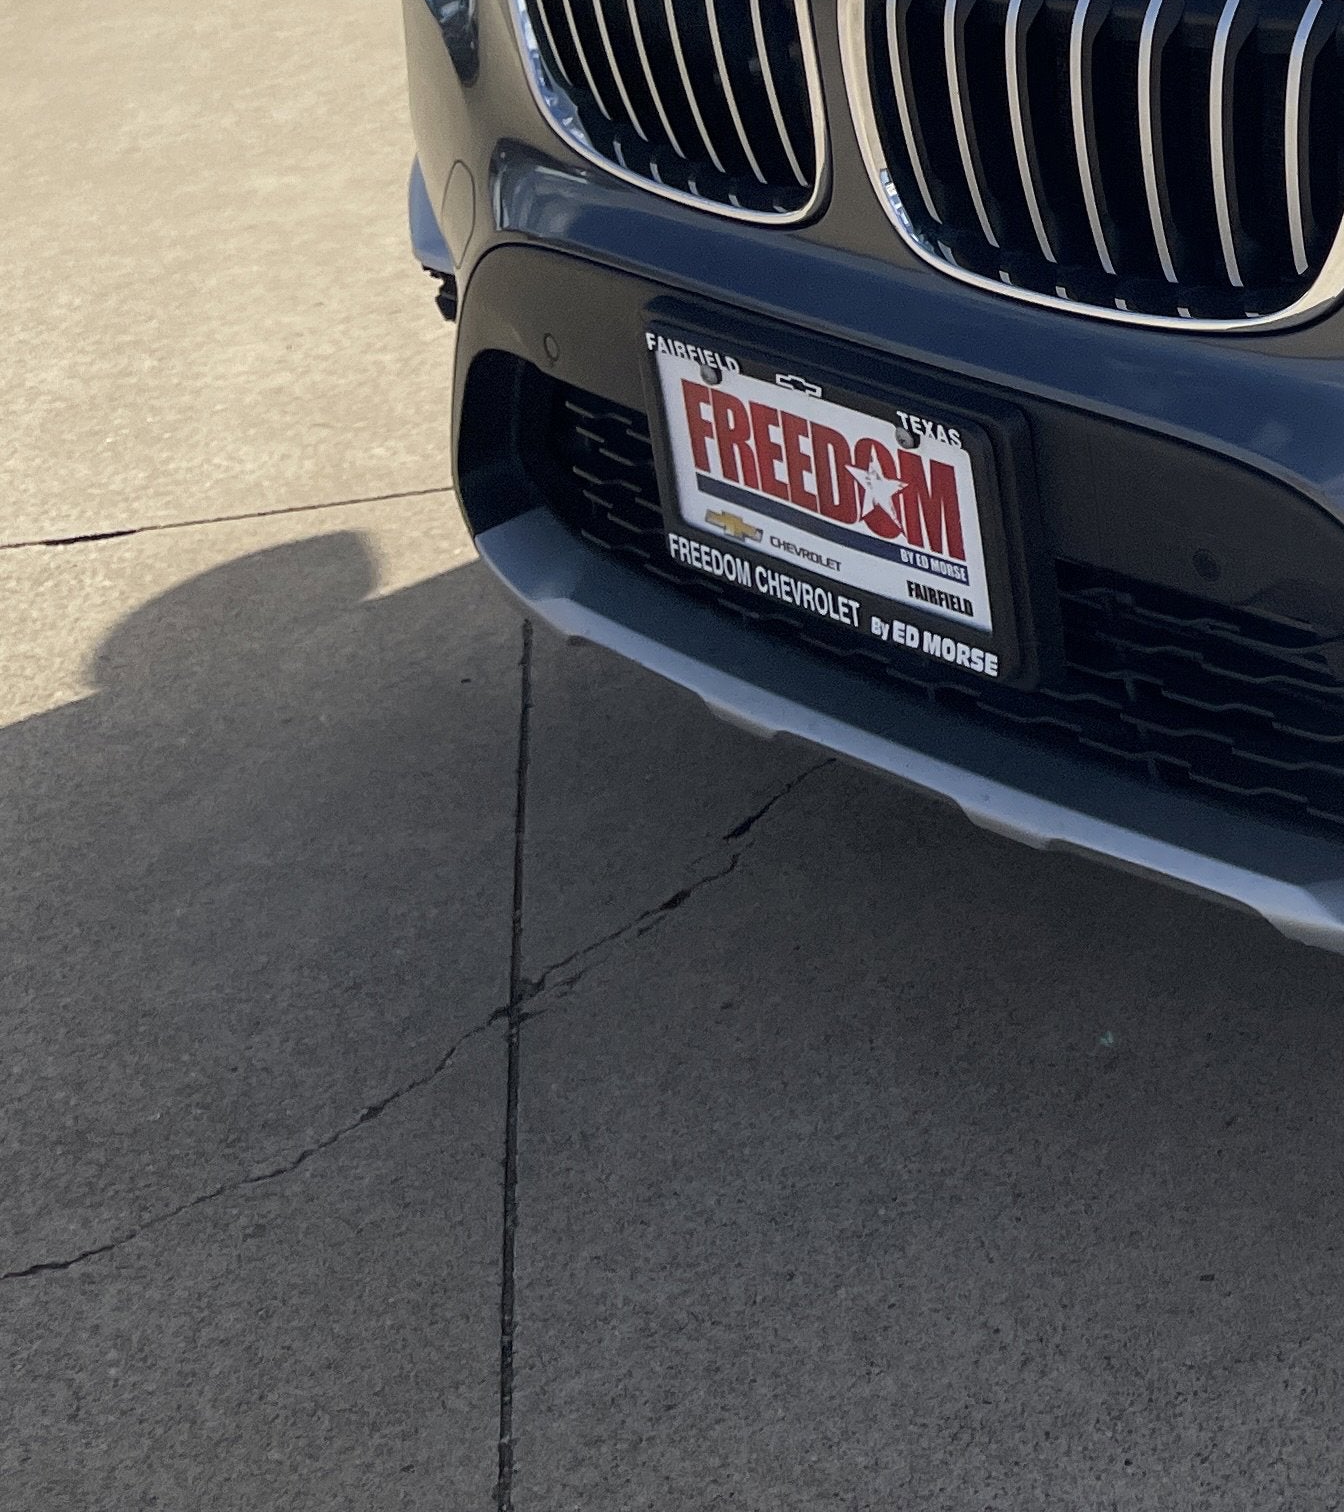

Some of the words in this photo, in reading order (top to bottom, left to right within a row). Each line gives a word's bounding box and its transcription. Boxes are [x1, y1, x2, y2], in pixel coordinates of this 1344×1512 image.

[645, 332, 740, 375] FAIRFIELD
[896, 410, 963, 450] TEXAS
[681, 378, 967, 562] FREEDOM
[769, 536, 842, 573] CHEVROLET
[900, 548, 915, 564] BY
[916, 552, 930, 571] ED
[930, 558, 968, 583] MORSE
[668, 533, 753, 589] FREEDOM
[755, 566, 861, 628] CHEVROLET
[870, 616, 890, 642] By
[892, 620, 920, 649] ED
[923, 631, 999, 678] MORSE
[906, 579, 974, 617] FAIRFIELD
